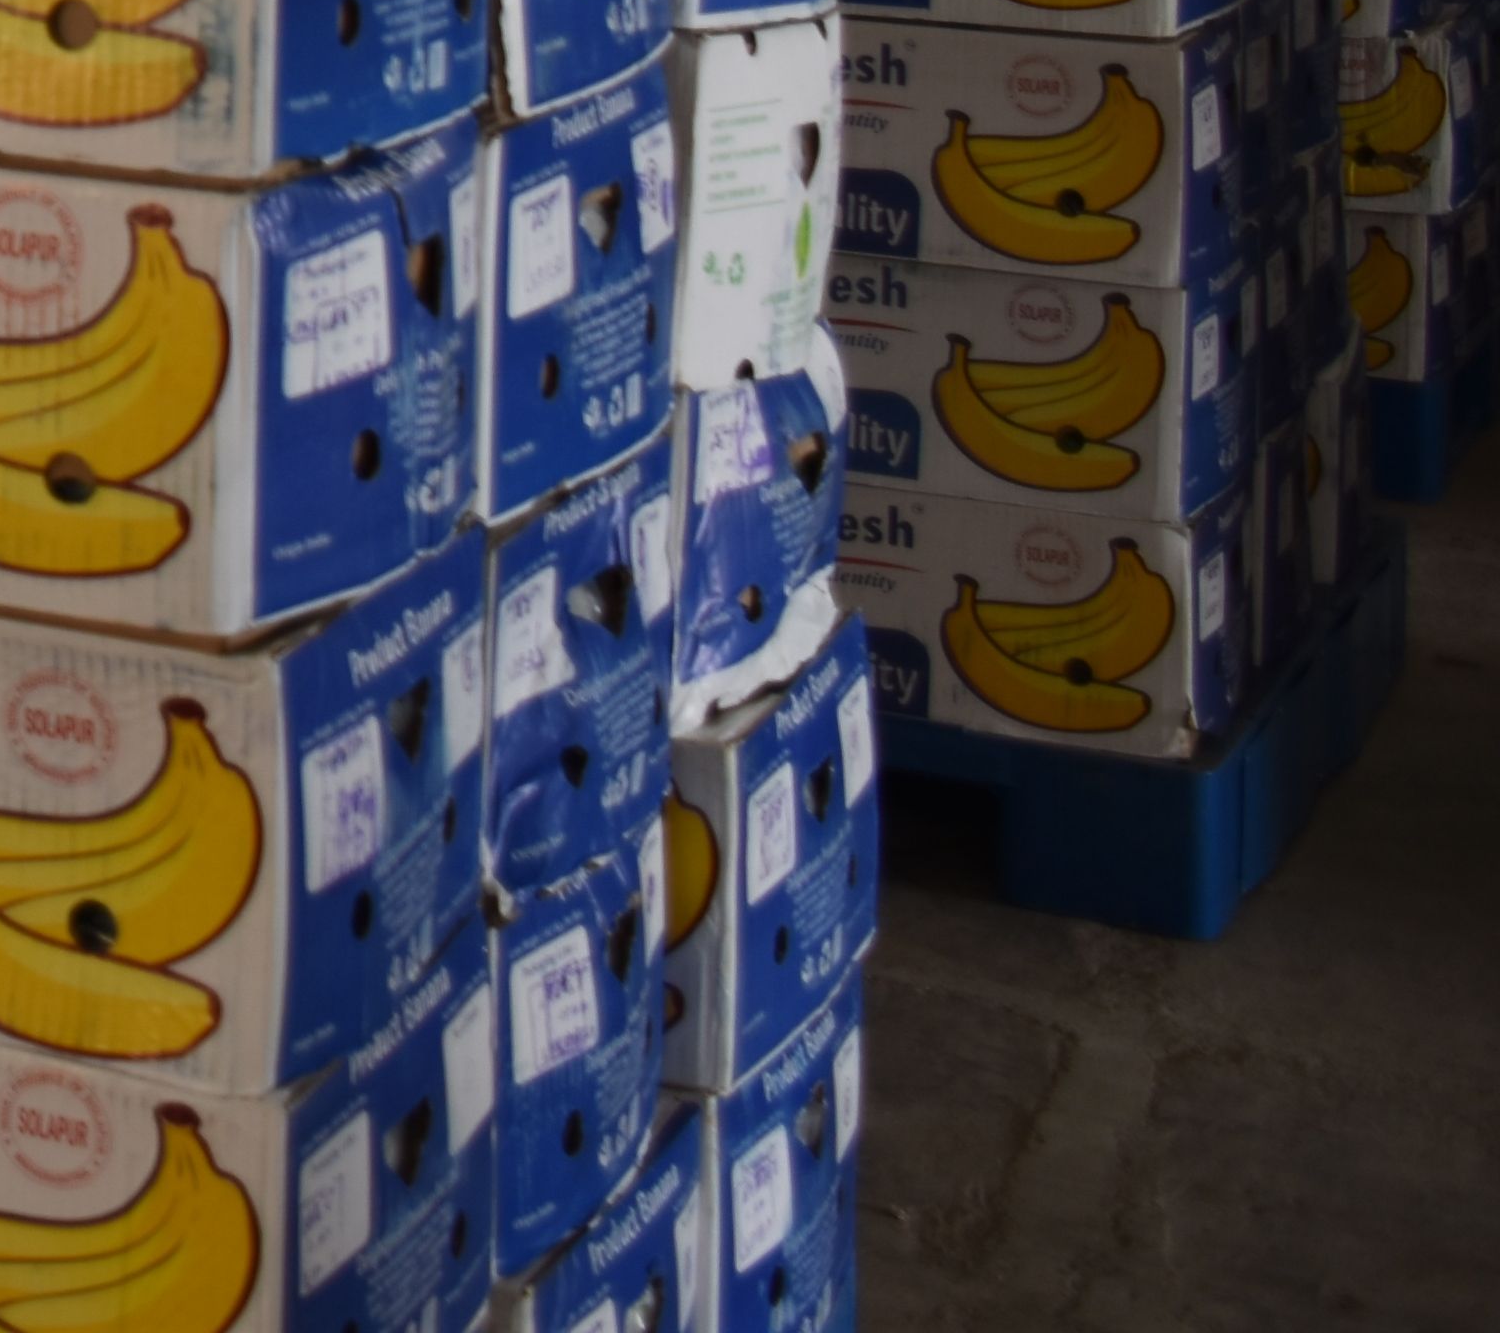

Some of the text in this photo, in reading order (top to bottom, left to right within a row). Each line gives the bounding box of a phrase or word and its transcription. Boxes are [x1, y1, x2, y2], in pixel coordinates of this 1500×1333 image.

[842, 189, 908, 246] lity
[849, 407, 908, 465] lity
[24, 708, 95, 744] SOLAPUR
[18, 1107, 88, 1147] SOLAPUR
